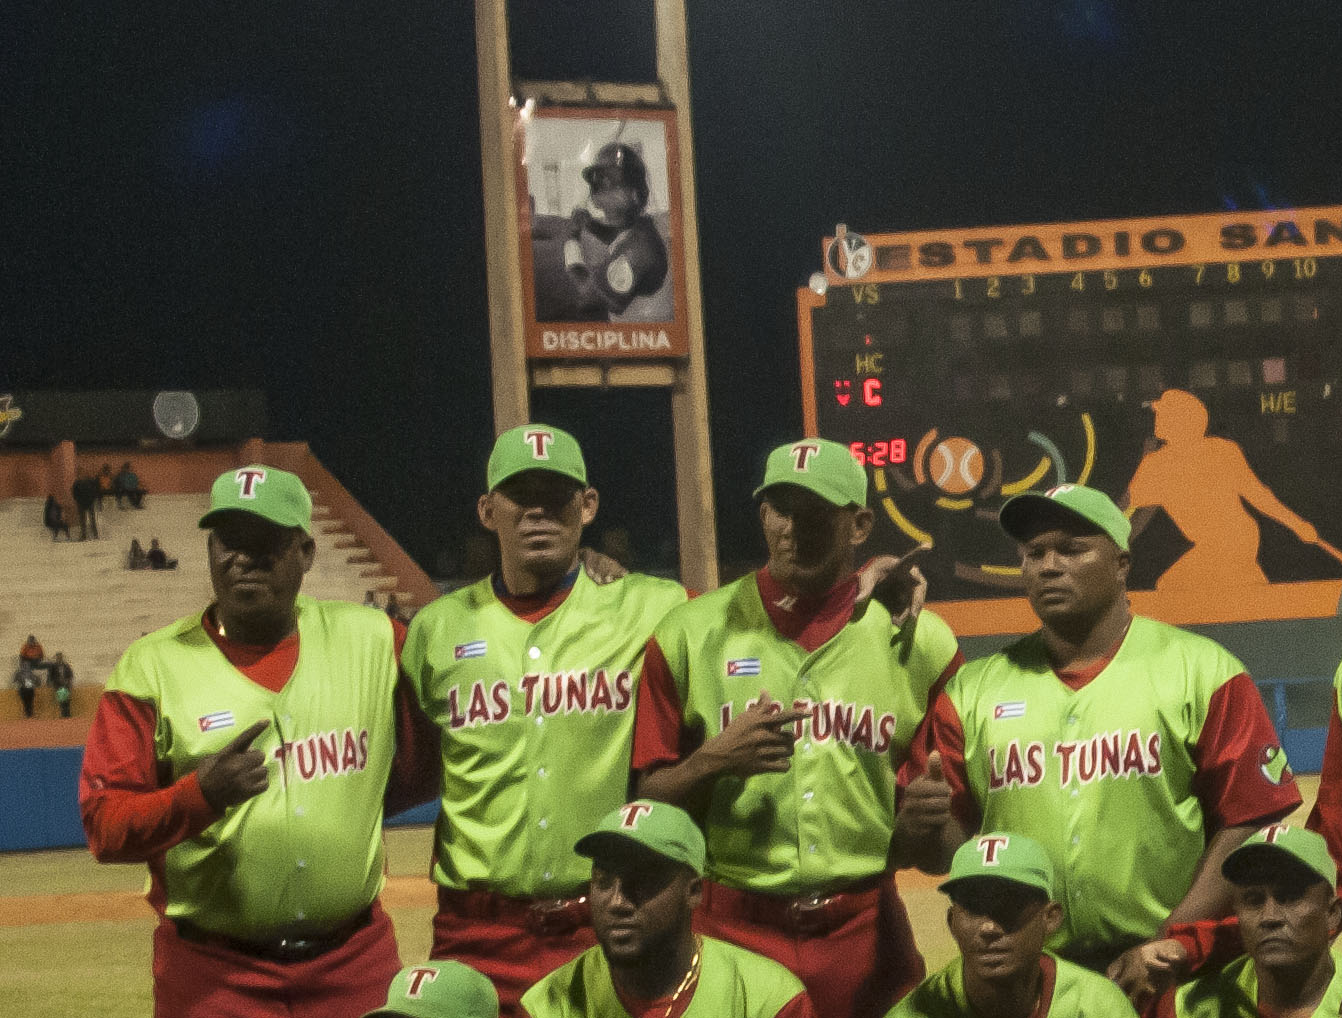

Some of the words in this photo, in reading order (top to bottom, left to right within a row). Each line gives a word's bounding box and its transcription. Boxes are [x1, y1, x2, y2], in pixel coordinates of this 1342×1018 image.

[876, 228, 1185, 271] ESTADIO
[853, 284, 879, 304] VS
[953, 279, 962, 299] 1
[987, 277, 1001, 298] 2
[1022, 274, 1036, 295] 3
[1071, 271, 1085, 291] 4
[1104, 270, 1118, 290] 5
[1139, 268, 1153, 288] 6
[1194, 264, 1205, 285] 7
[1227, 262, 1241, 283] 8
[1262, 260, 1275, 280] 9
[1294, 258, 1317, 278] 10
[542, 330, 671, 350] DISCIPLINA
[856, 353, 883, 375] HC
[1261, 391, 1296, 414] H/E
[524, 431, 553, 460] T
[791, 444, 820, 472] T
[234, 469, 266, 499] T
[448, 680, 509, 732] LAS
[521, 669, 632, 716] TUNAS
[792, 697, 896, 753] TUNAS
[273, 727, 368, 787] TUNAS
[987, 740, 1045, 791] LAS
[1054, 728, 1162, 785] TUNAS
[619, 802, 652, 830] T
[1261, 824, 1289, 843] T
[977, 836, 1008, 866] T
[407, 967, 439, 998] T
